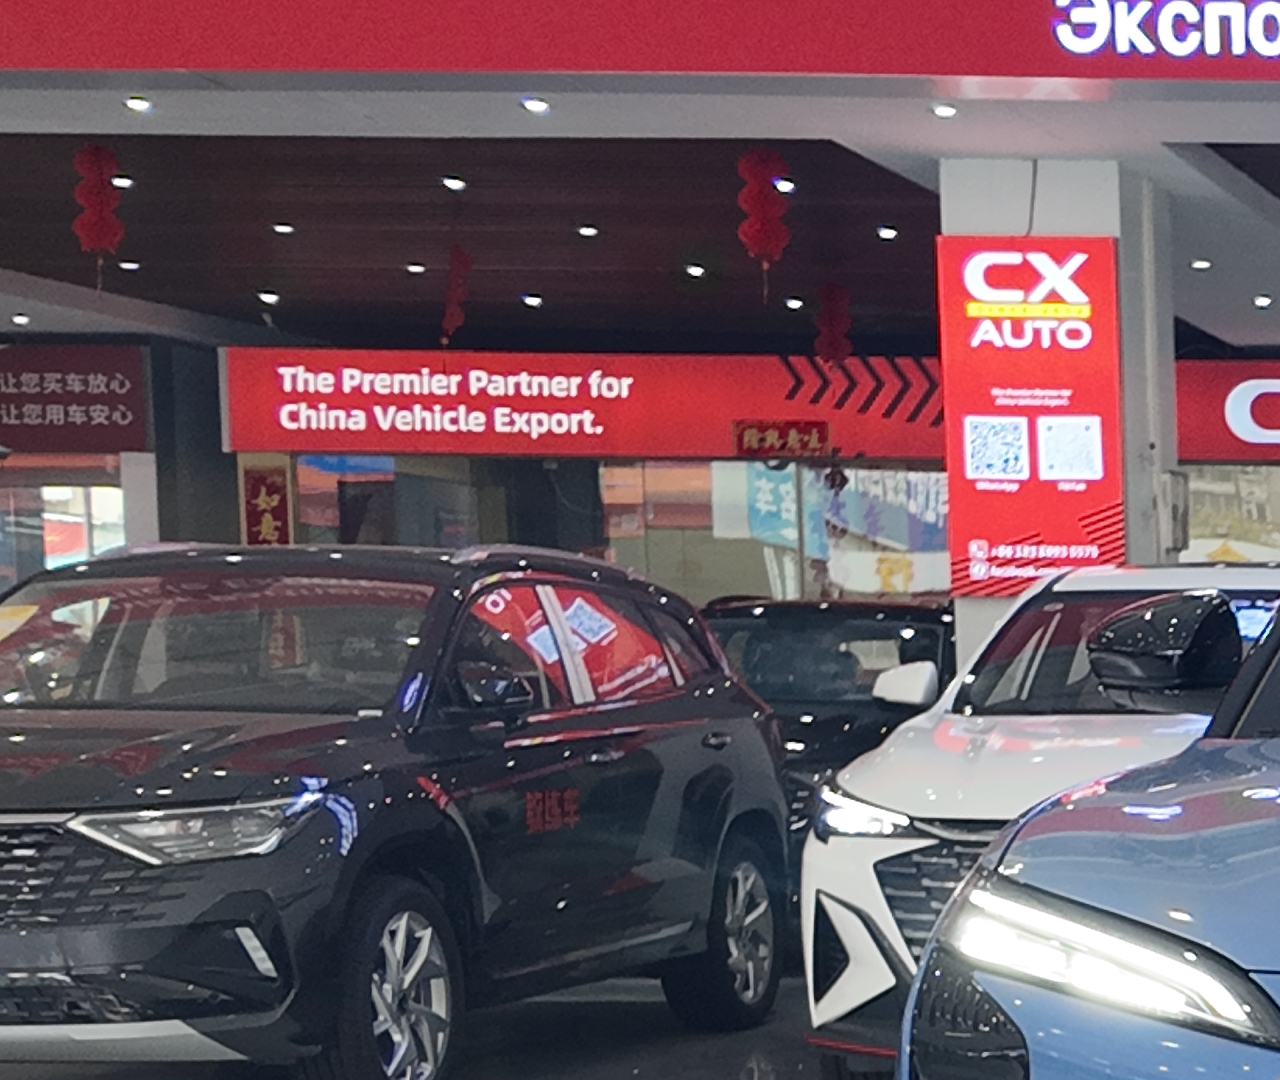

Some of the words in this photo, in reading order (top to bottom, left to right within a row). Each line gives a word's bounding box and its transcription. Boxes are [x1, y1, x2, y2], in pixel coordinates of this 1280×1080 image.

[964, 251, 1090, 303] CX
[970, 319, 1093, 350] AUTO
[0, 372, 132, 395] 让您买车放心
[277, 365, 335, 393] The
[341, 367, 463, 395] Premier
[468, 370, 583, 397] Partner
[587, 370, 634, 398] for
[0, 403, 134, 426] 让您用车安心
[279, 402, 367, 430] China
[372, 404, 487, 432] Vehicle
[493, 407, 604, 440] Export.
